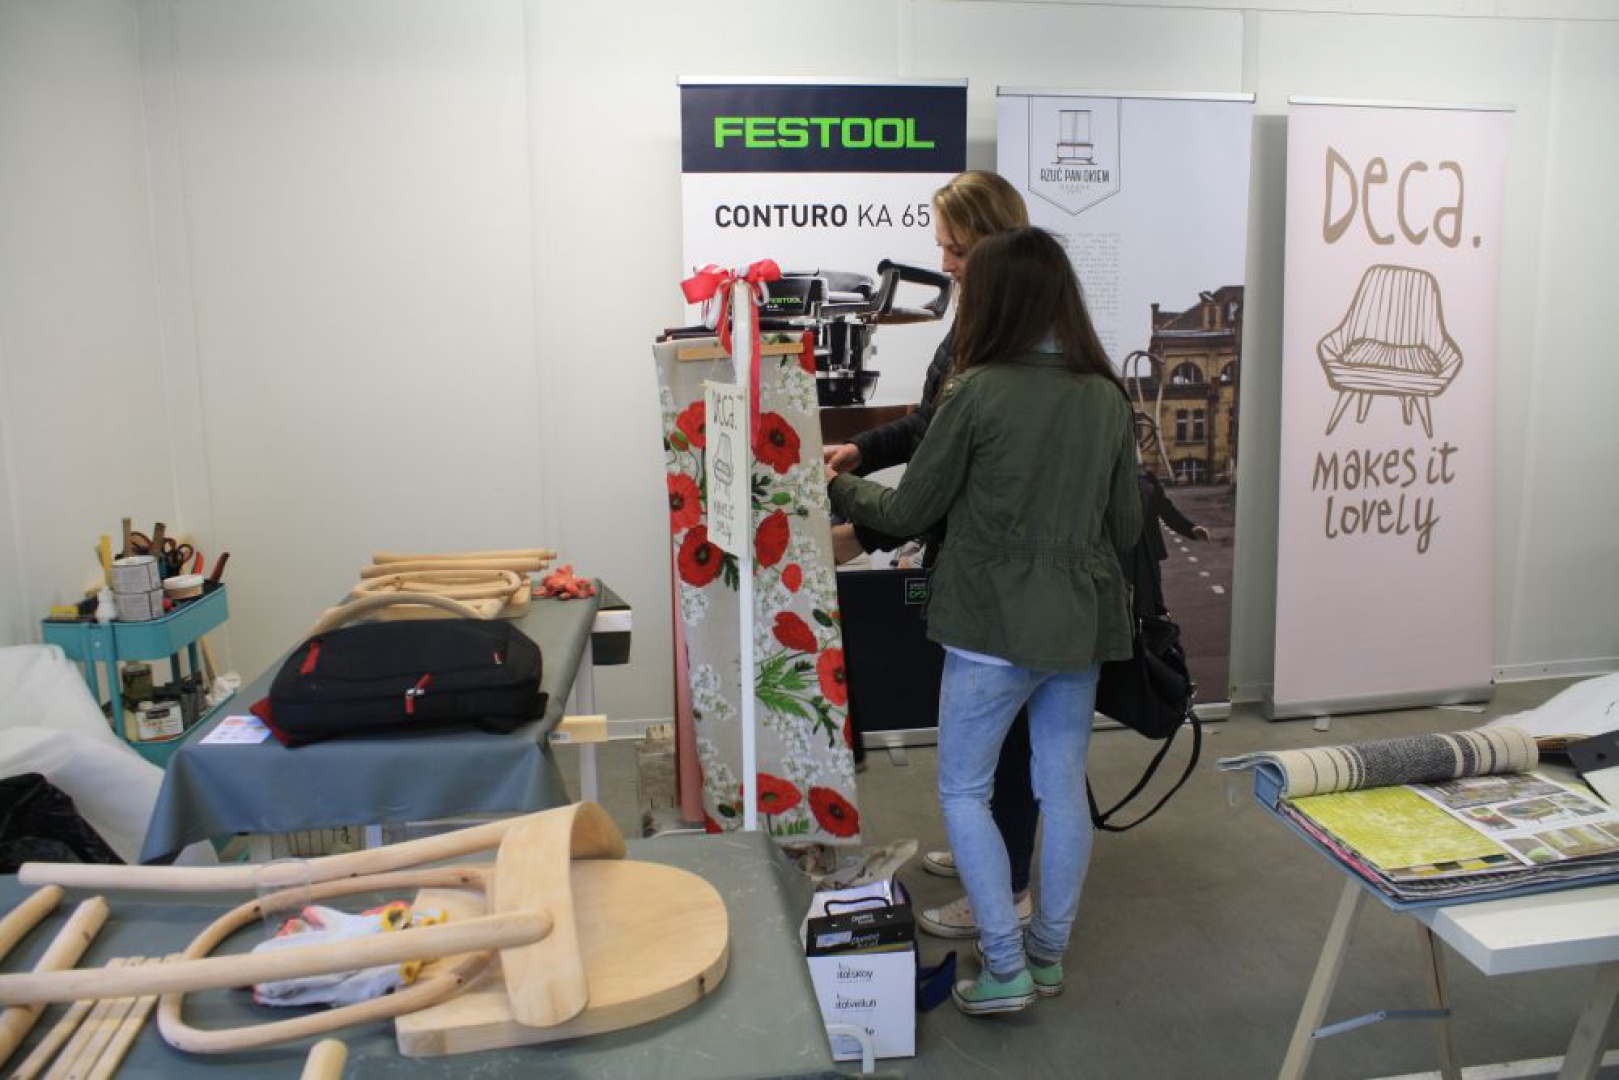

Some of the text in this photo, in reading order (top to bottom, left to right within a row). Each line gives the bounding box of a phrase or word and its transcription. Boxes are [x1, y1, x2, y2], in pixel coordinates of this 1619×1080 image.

[714, 117, 935, 149] FESTOOL
[1064, 169, 1082, 182] PAN
[715, 204, 931, 228] CONTURO KA 65
[1323, 147, 1481, 249] Deca.
[1425, 441, 1459, 489] it
[1325, 493, 1442, 556] lovely
